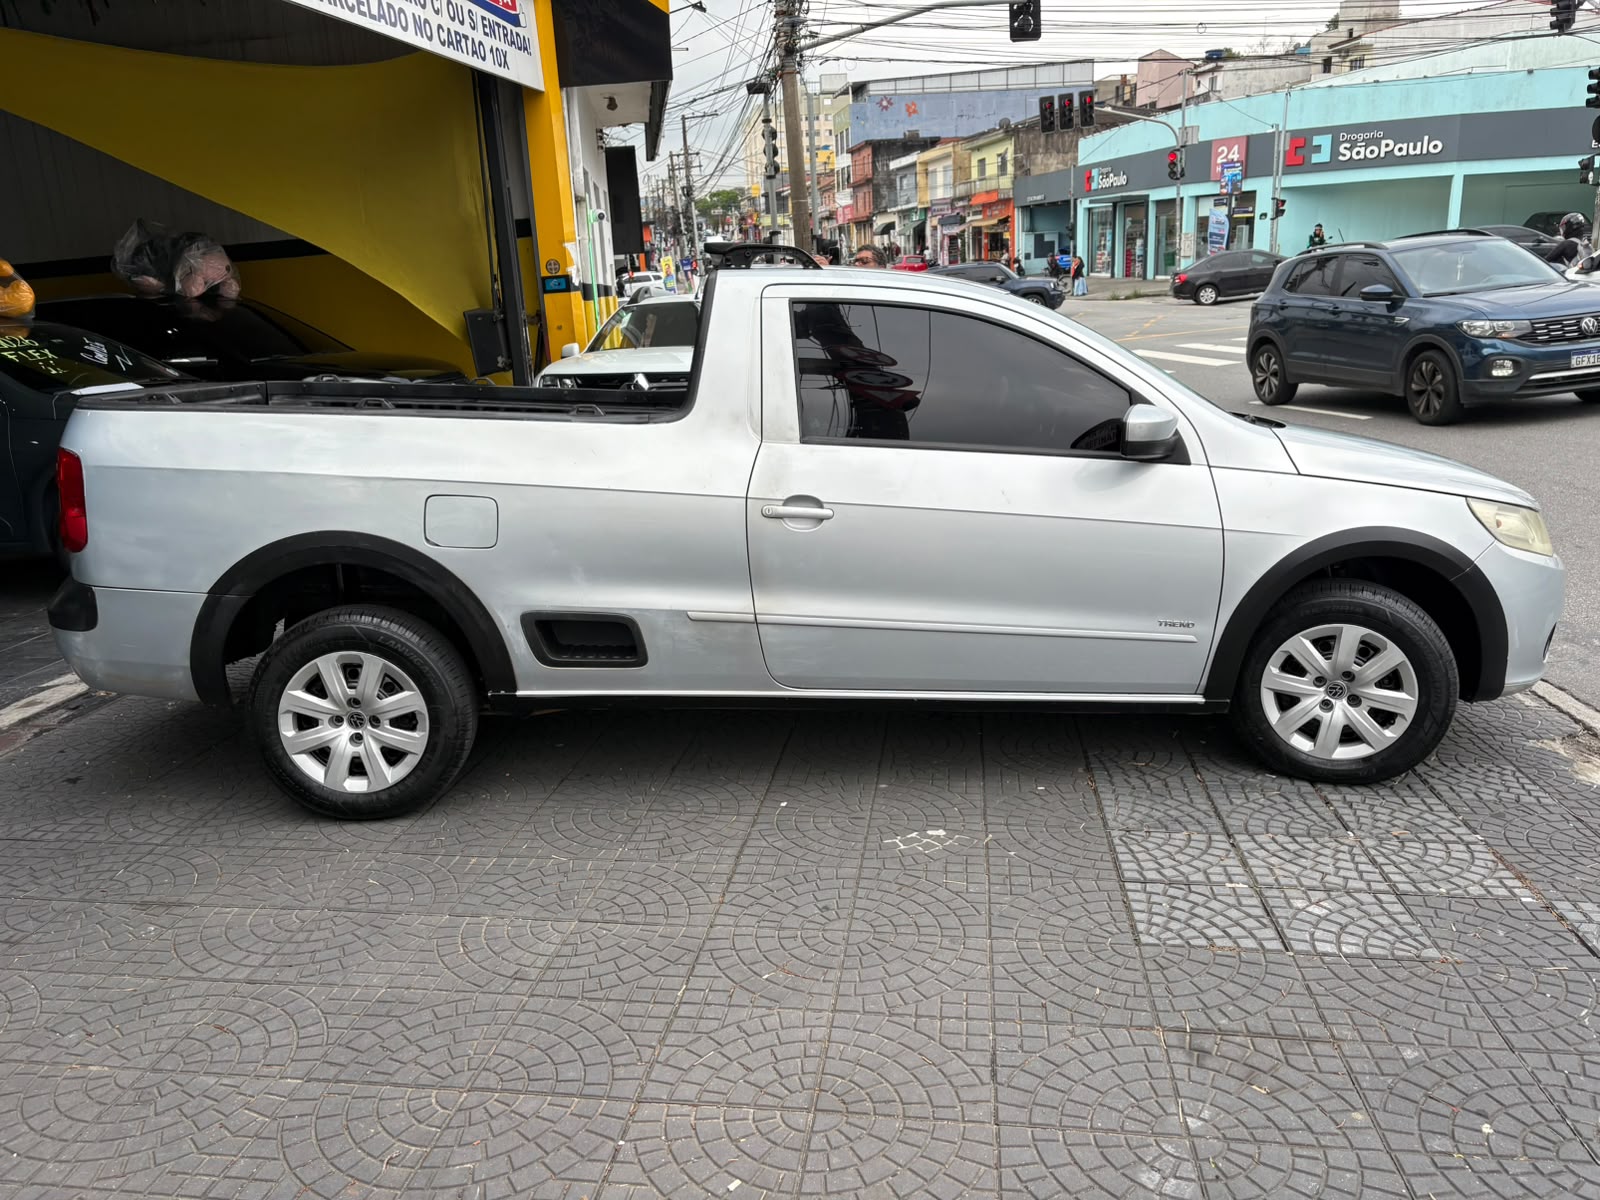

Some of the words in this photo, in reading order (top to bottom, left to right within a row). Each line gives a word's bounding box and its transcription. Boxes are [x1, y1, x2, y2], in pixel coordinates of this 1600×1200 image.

[446, 0, 464, 26] OU
[480, 15, 532, 56] ENTRADA!
[412, 12, 433, 42] NO
[489, 44, 510, 70] 10X
[1339, 130, 1384, 143] Drogaria
[1217, 144, 1240, 163] 24
[1157, 620, 1195, 629] TREND
